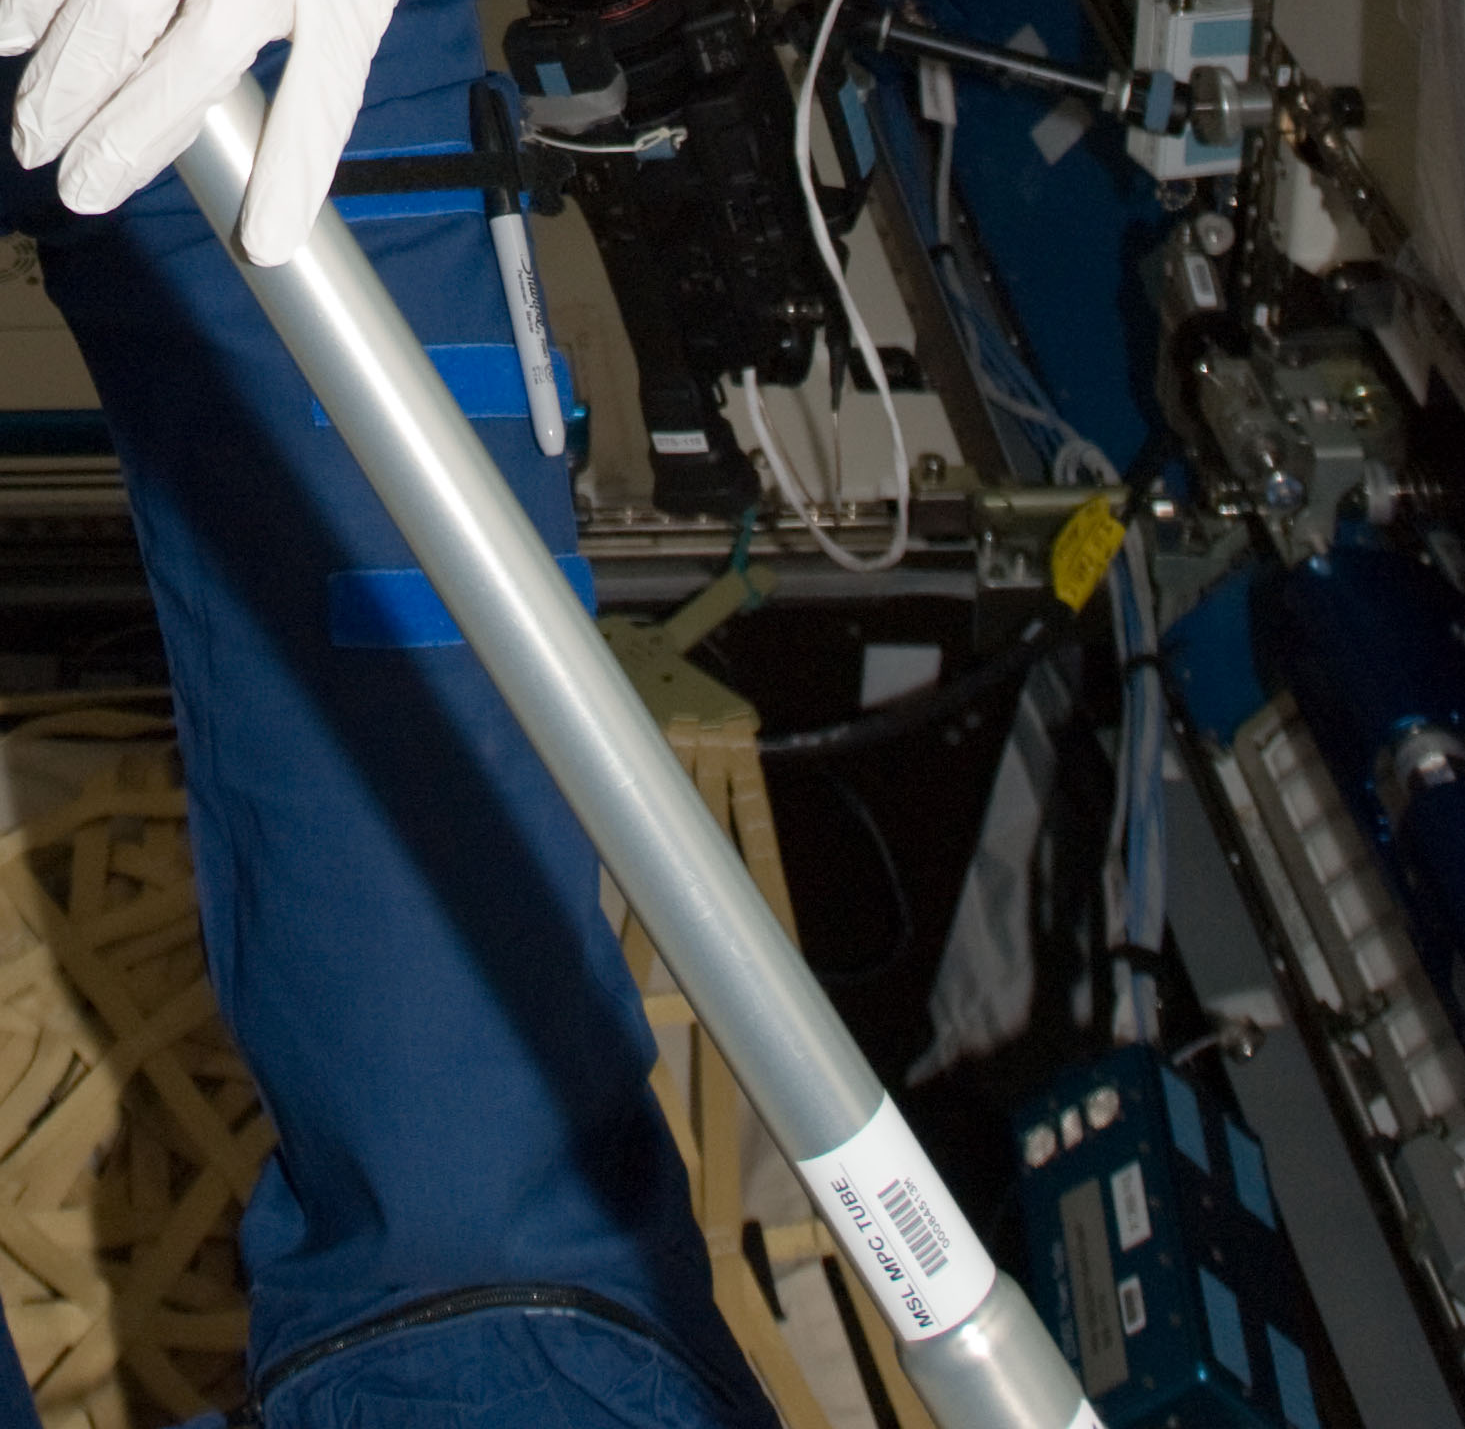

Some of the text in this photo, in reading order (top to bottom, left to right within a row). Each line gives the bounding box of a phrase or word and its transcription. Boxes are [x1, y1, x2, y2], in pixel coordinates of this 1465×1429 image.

[830, 1177, 934, 1328] MSL MPC TUBE
